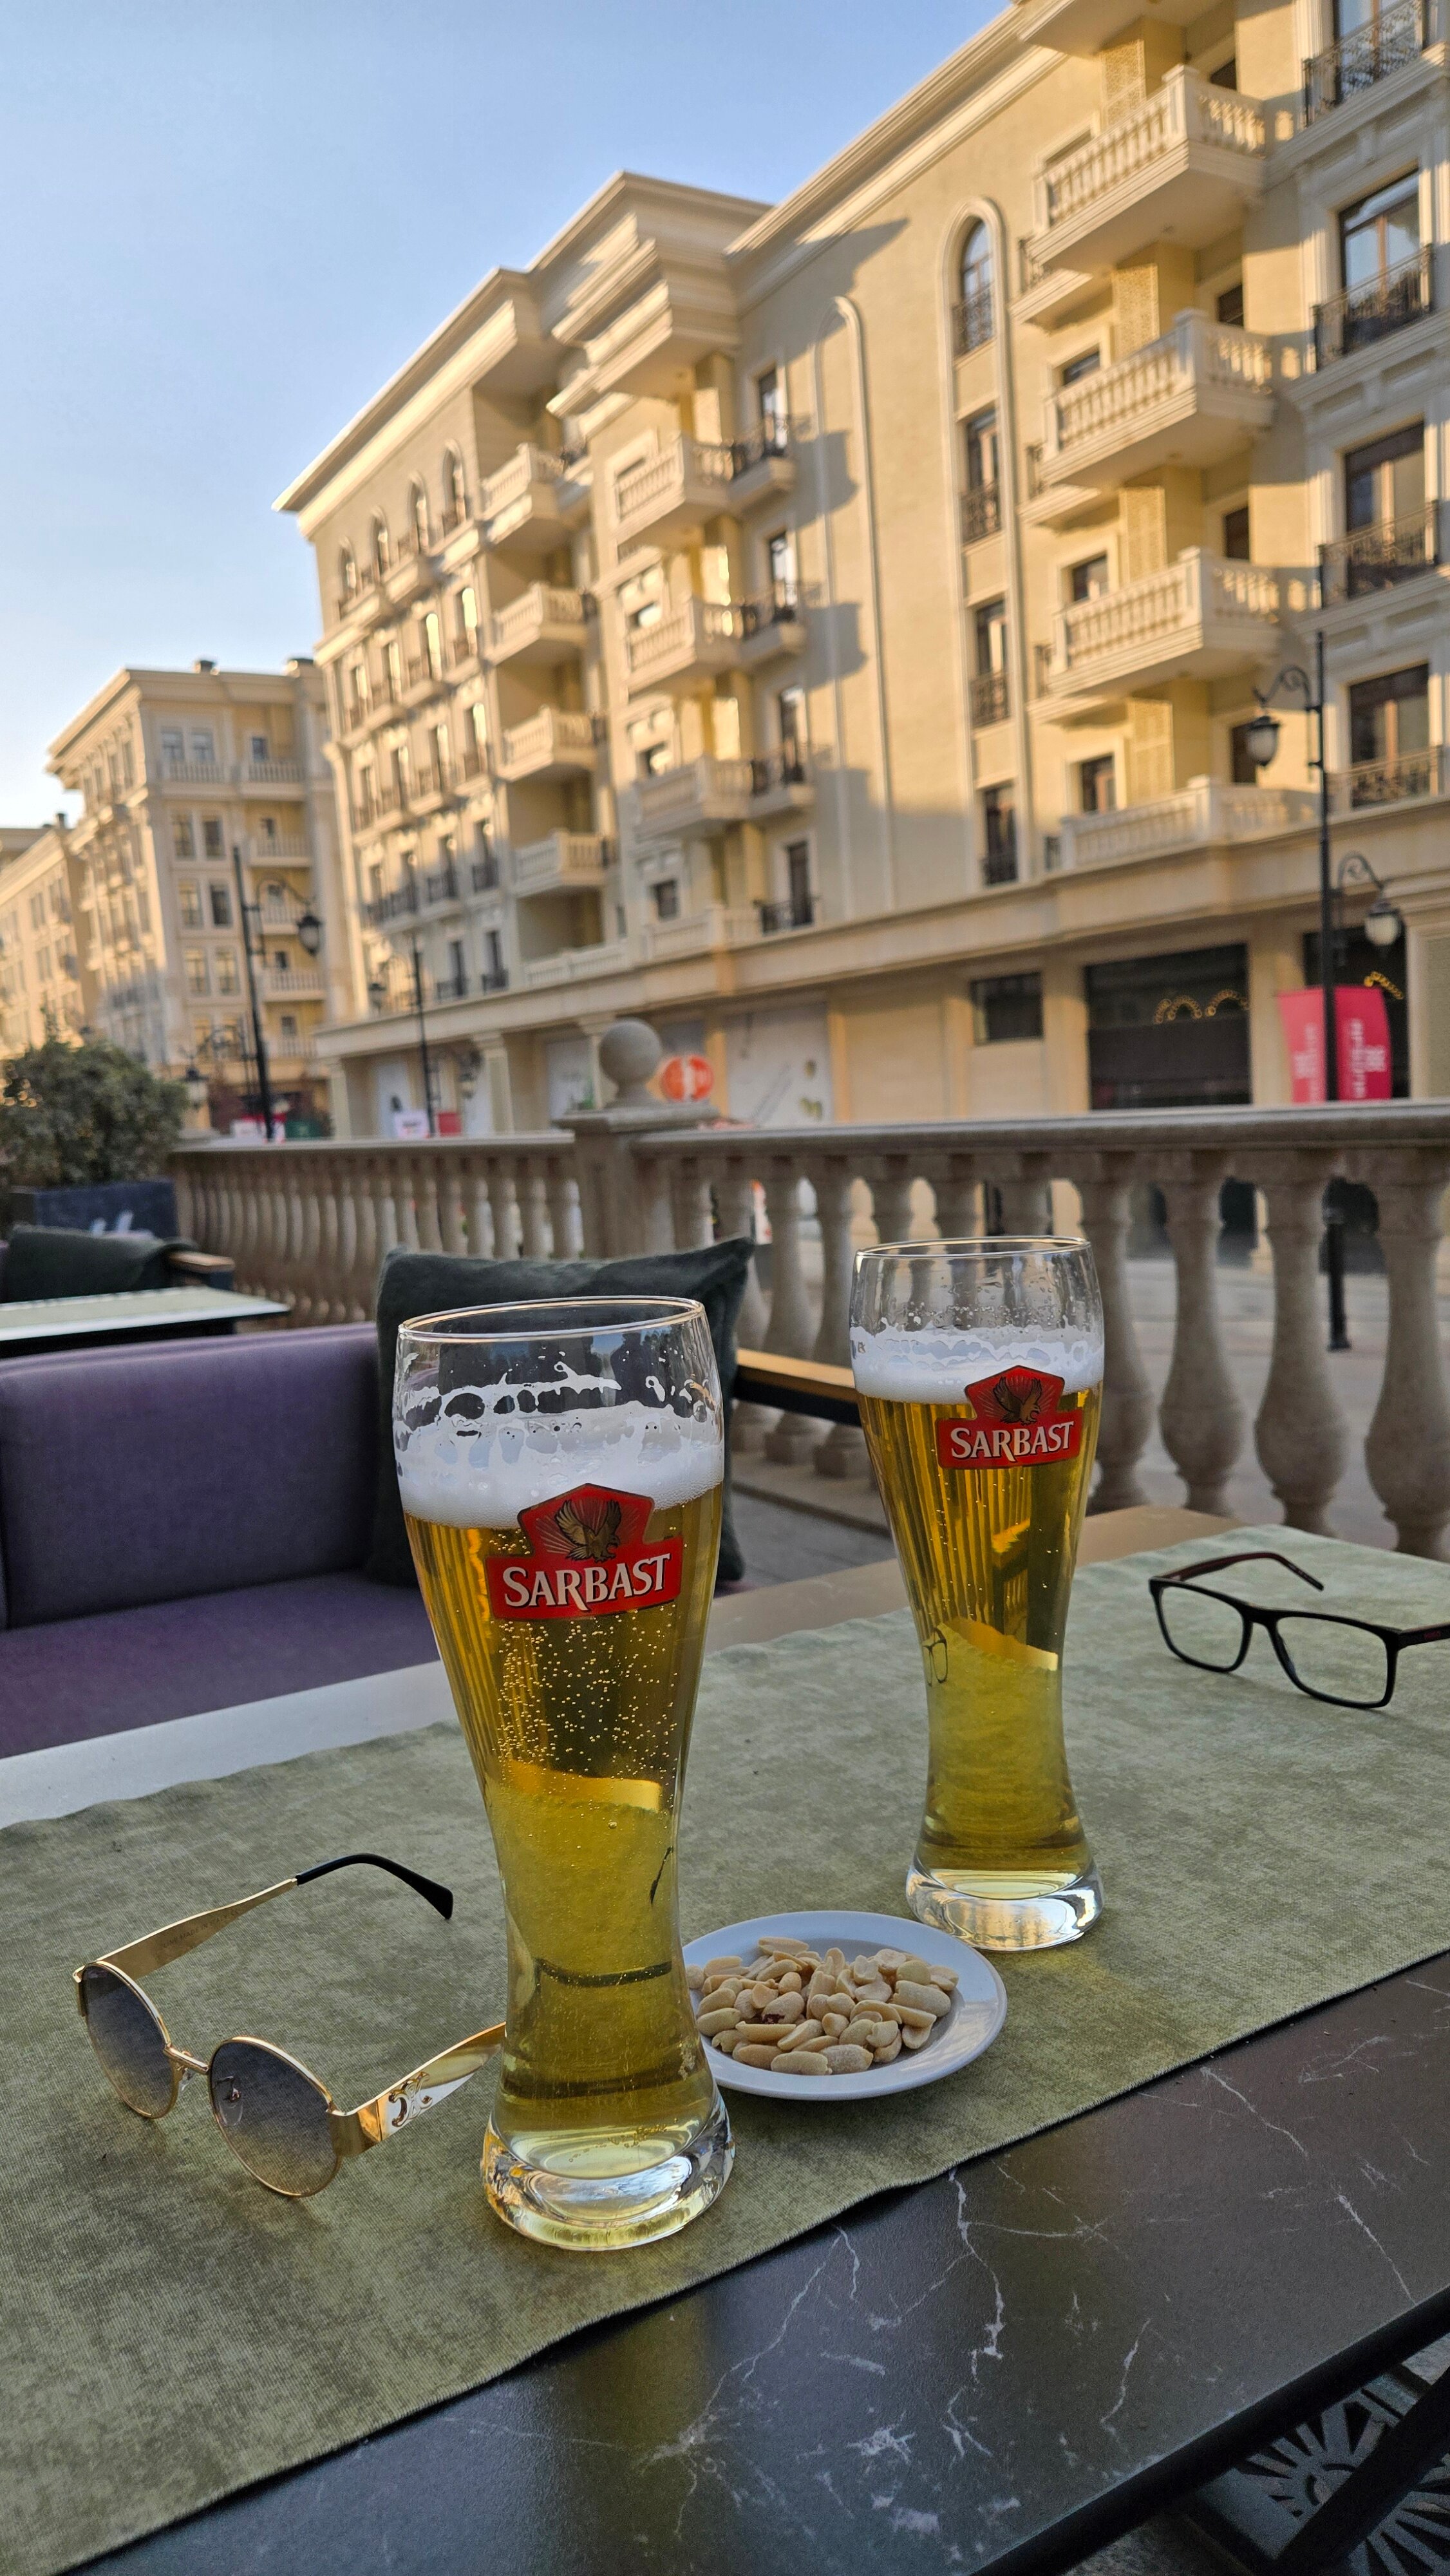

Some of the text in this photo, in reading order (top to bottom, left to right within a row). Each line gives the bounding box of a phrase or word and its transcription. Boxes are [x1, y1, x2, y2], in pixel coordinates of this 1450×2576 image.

[950, 1421, 1074, 1463] SARBAST
[502, 1553, 670, 1611] SARBAST
[180, 1927, 199, 1940] MADE
